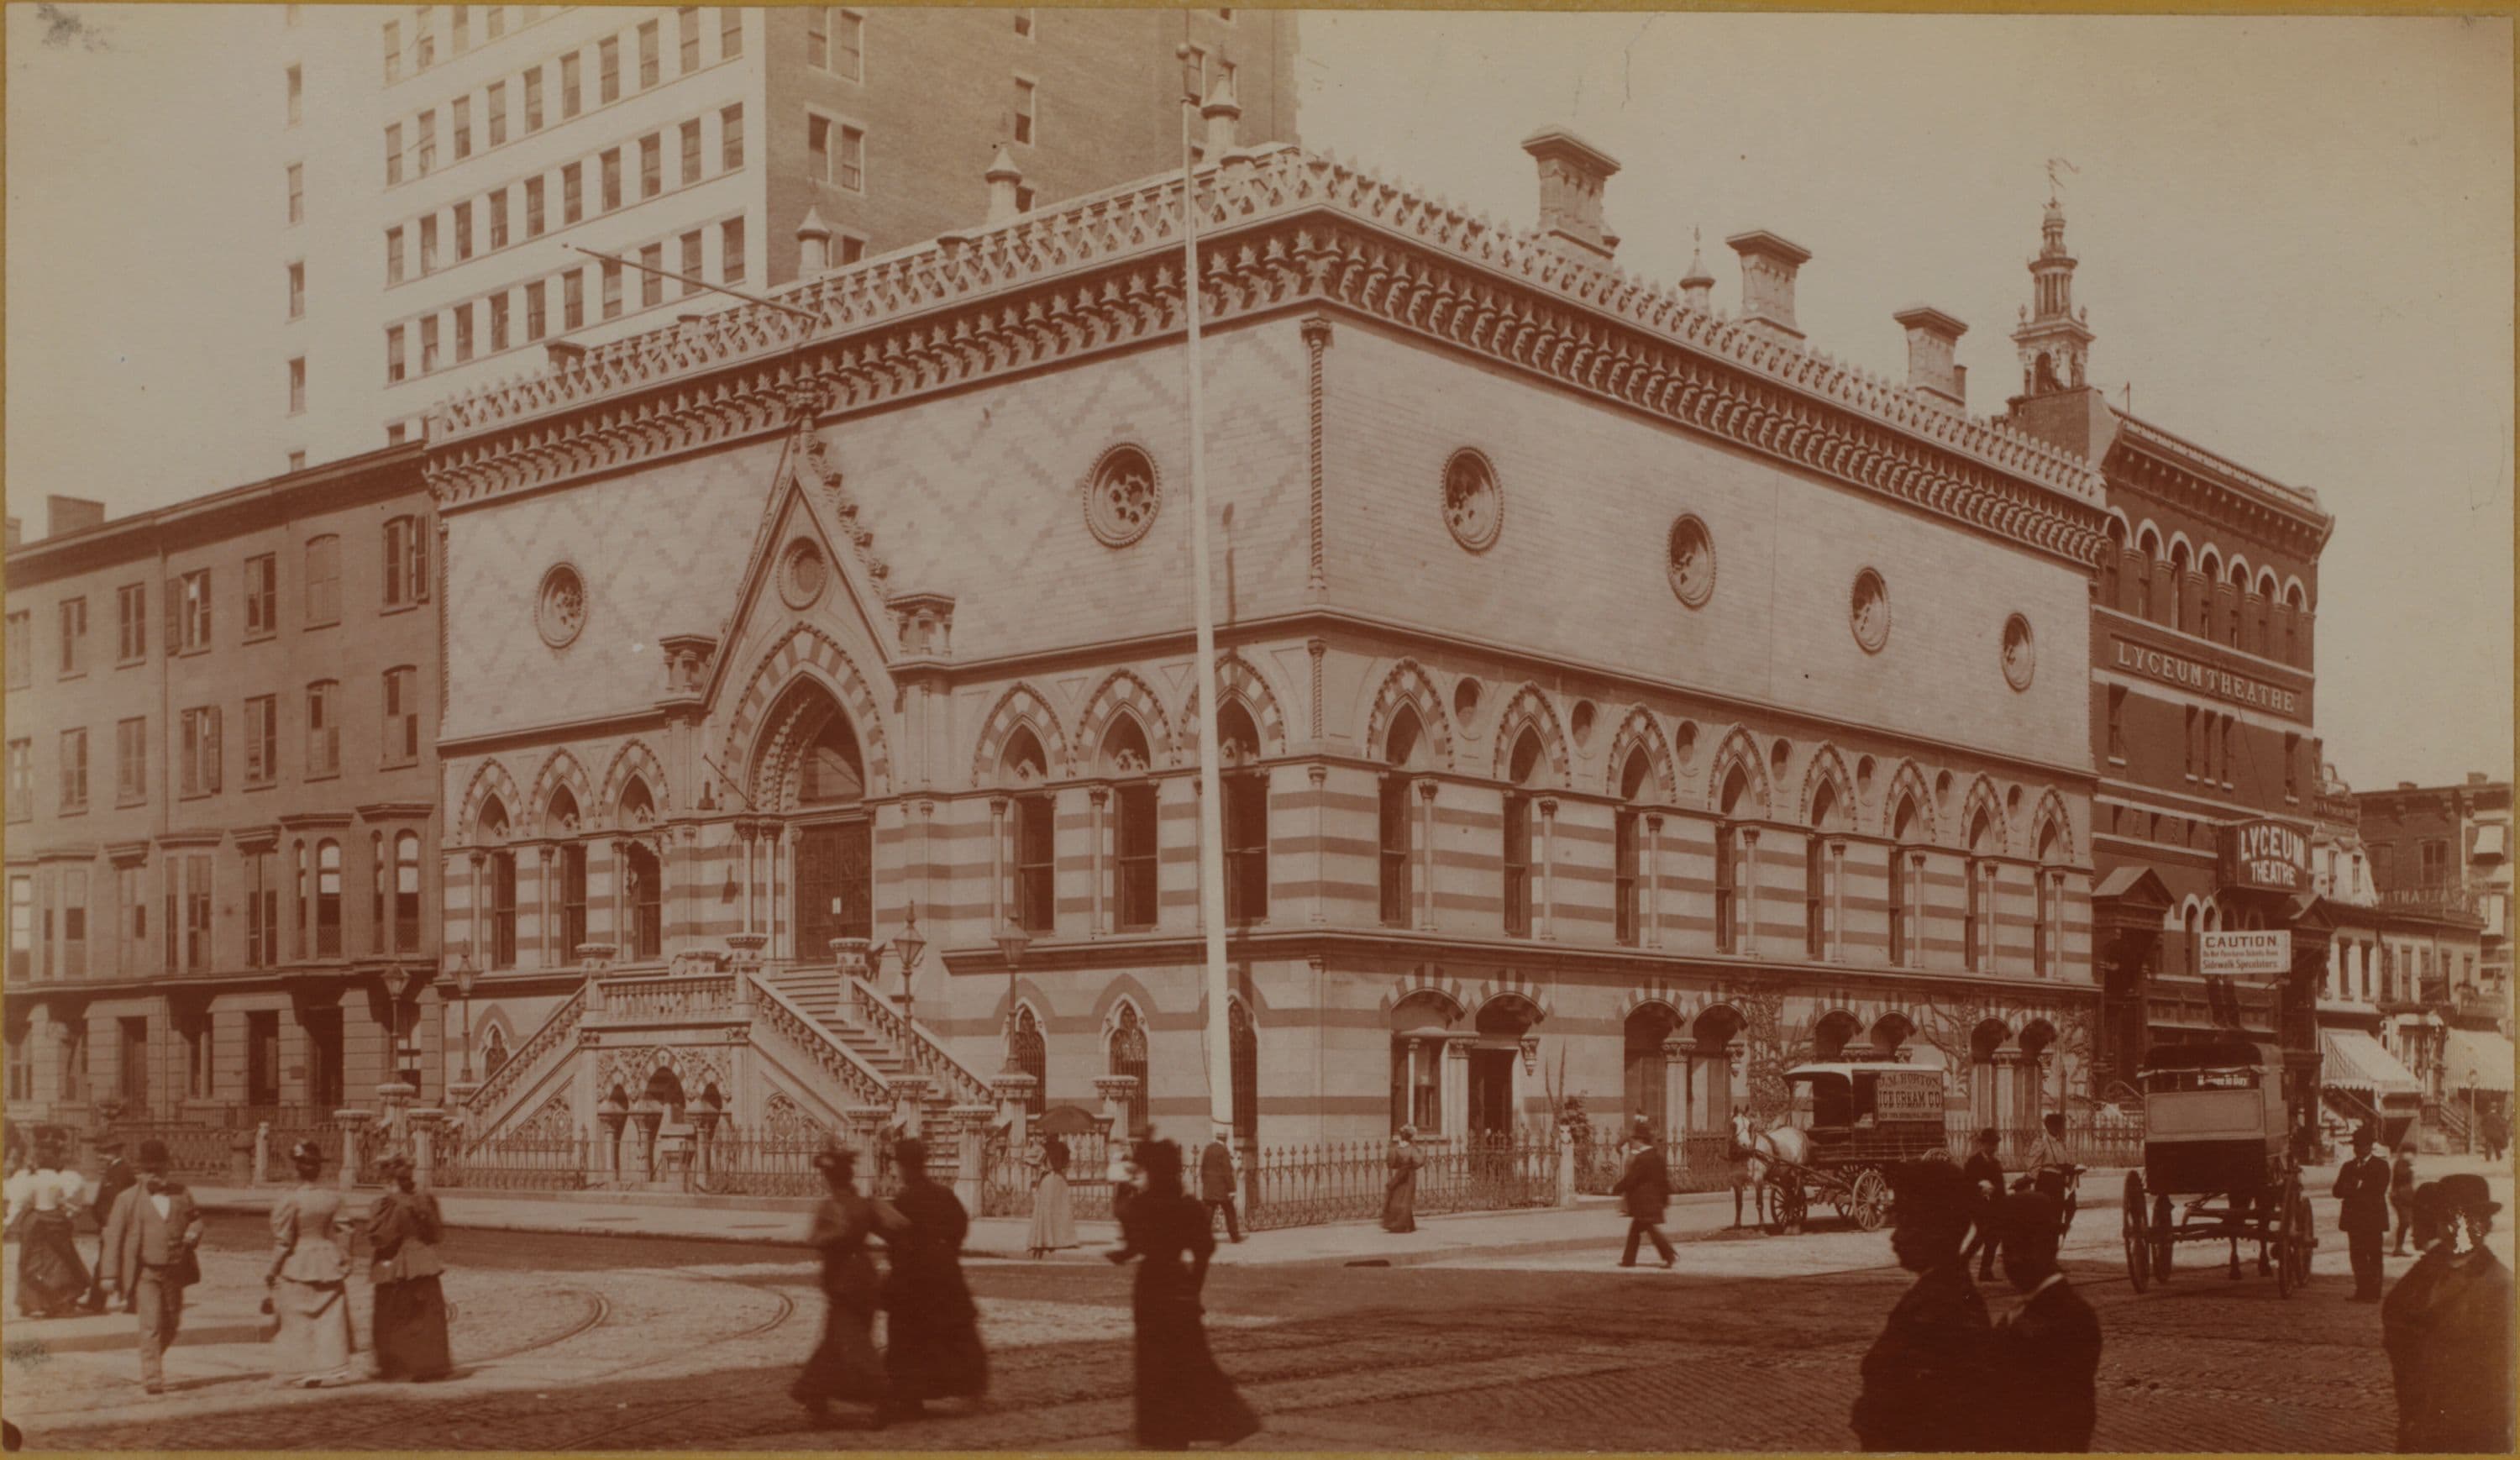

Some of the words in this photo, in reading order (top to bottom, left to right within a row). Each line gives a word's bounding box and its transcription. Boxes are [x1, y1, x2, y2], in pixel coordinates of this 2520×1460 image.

[2117, 642, 2202, 687] LYCEUM
[2206, 670, 2295, 713] THEATRE
[2240, 825, 2306, 870] LYCEUM
[2251, 859, 2296, 886] THEATRE
[2205, 935, 2277, 948] CAUTION
[2202, 958, 2234, 969] Sidewalk
[1900, 1073, 1940, 1087] HORTON
[1878, 1090, 1894, 1108] ICE
[1896, 1090, 1925, 1108] CREAM
